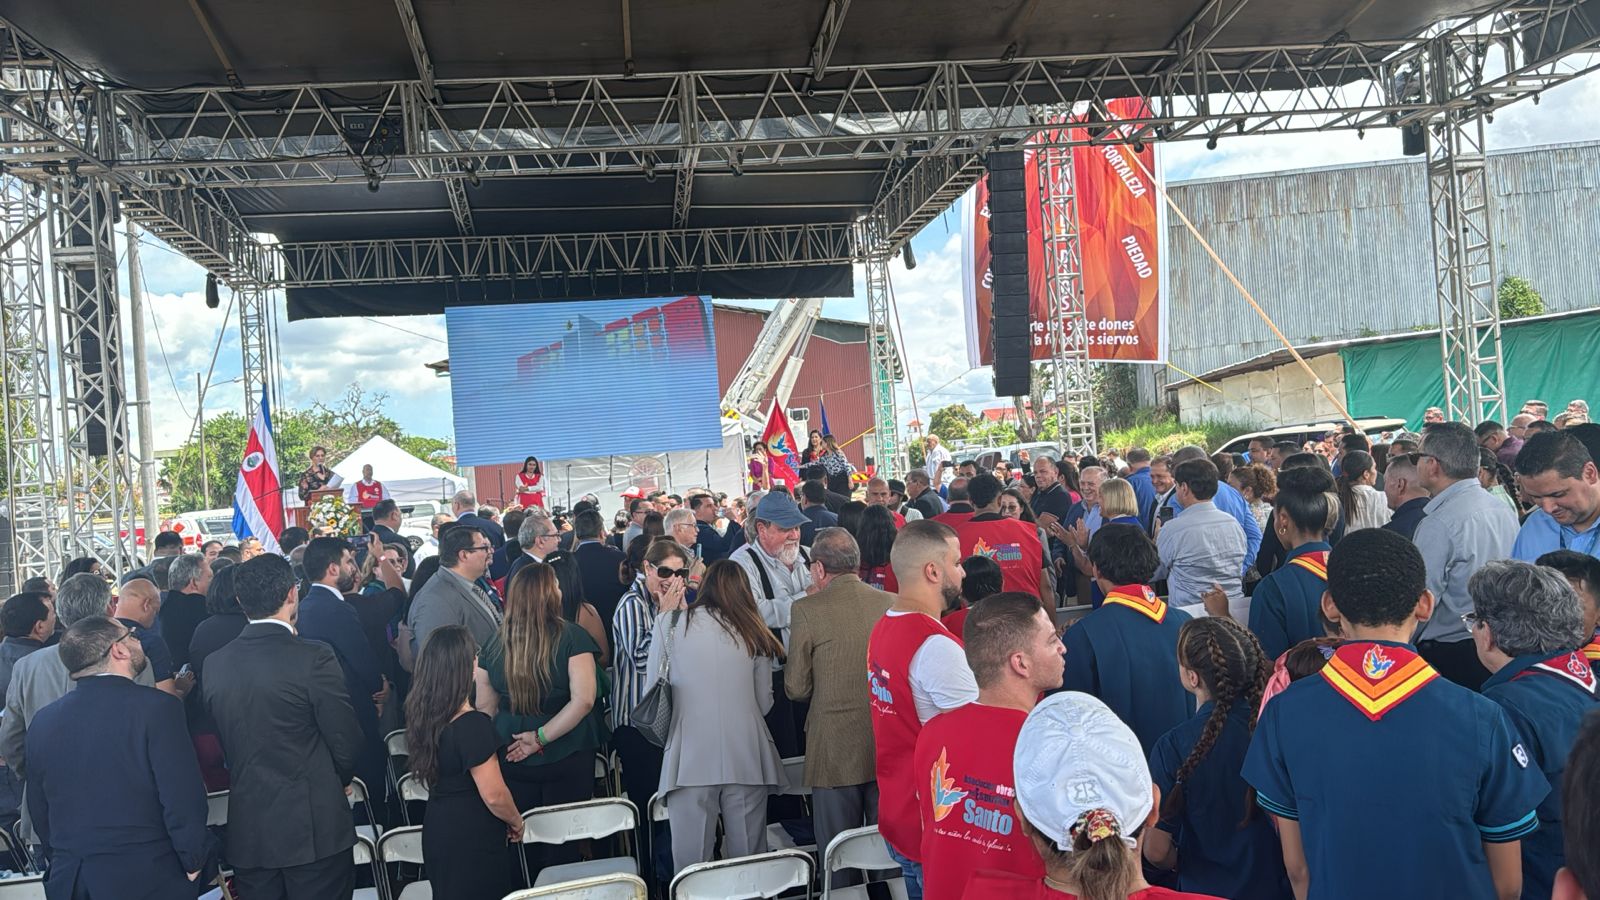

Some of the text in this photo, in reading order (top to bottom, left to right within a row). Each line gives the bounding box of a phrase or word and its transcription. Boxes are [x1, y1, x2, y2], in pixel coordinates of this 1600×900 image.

[1101, 145, 1147, 198] FORTALEZA
[1121, 235, 1152, 278] PIEDAD
[1099, 317, 1135, 330] dones
[1097, 333, 1139, 345] siervos
[996, 551, 1022, 561] Santo
[996, 784, 1015, 798] obras
[963, 798, 1013, 835] Santo
